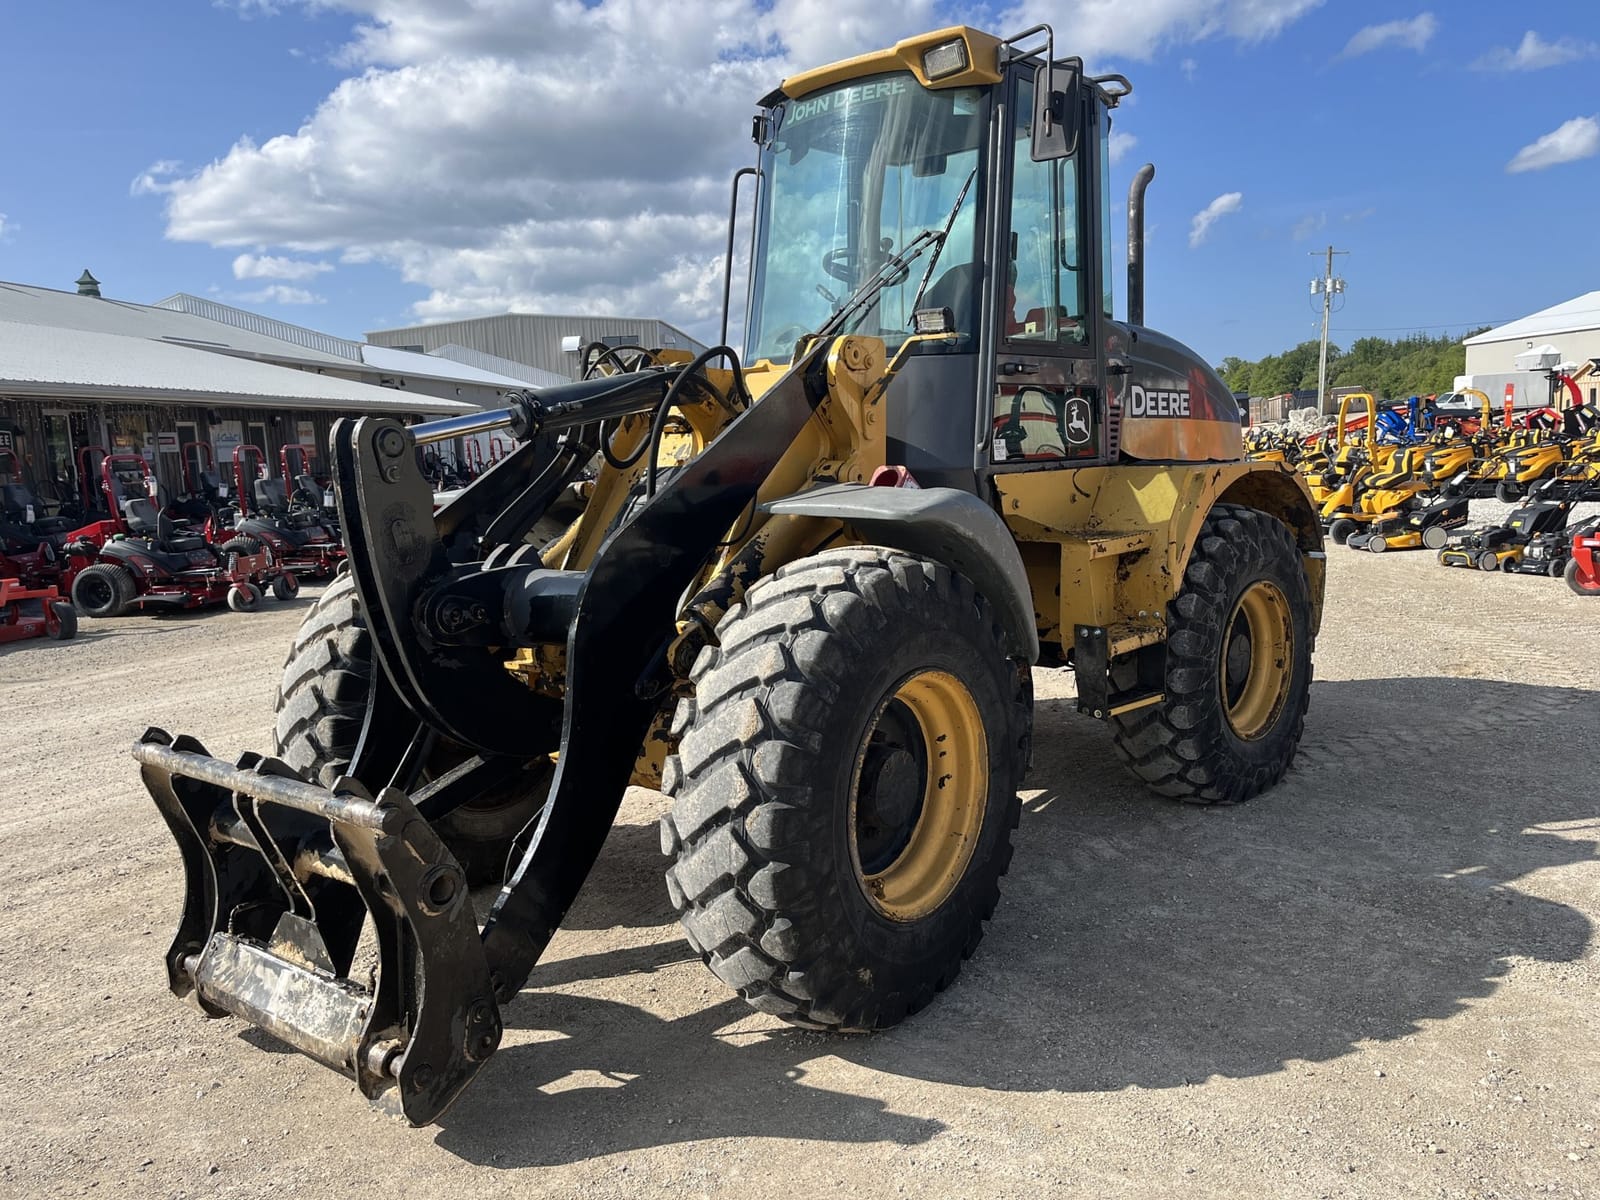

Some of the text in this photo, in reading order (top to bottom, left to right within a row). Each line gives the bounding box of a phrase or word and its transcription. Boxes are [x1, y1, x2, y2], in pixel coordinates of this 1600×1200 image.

[787, 81, 906, 125] JOHN DEERE
[1131, 385, 1190, 416] DEERE
